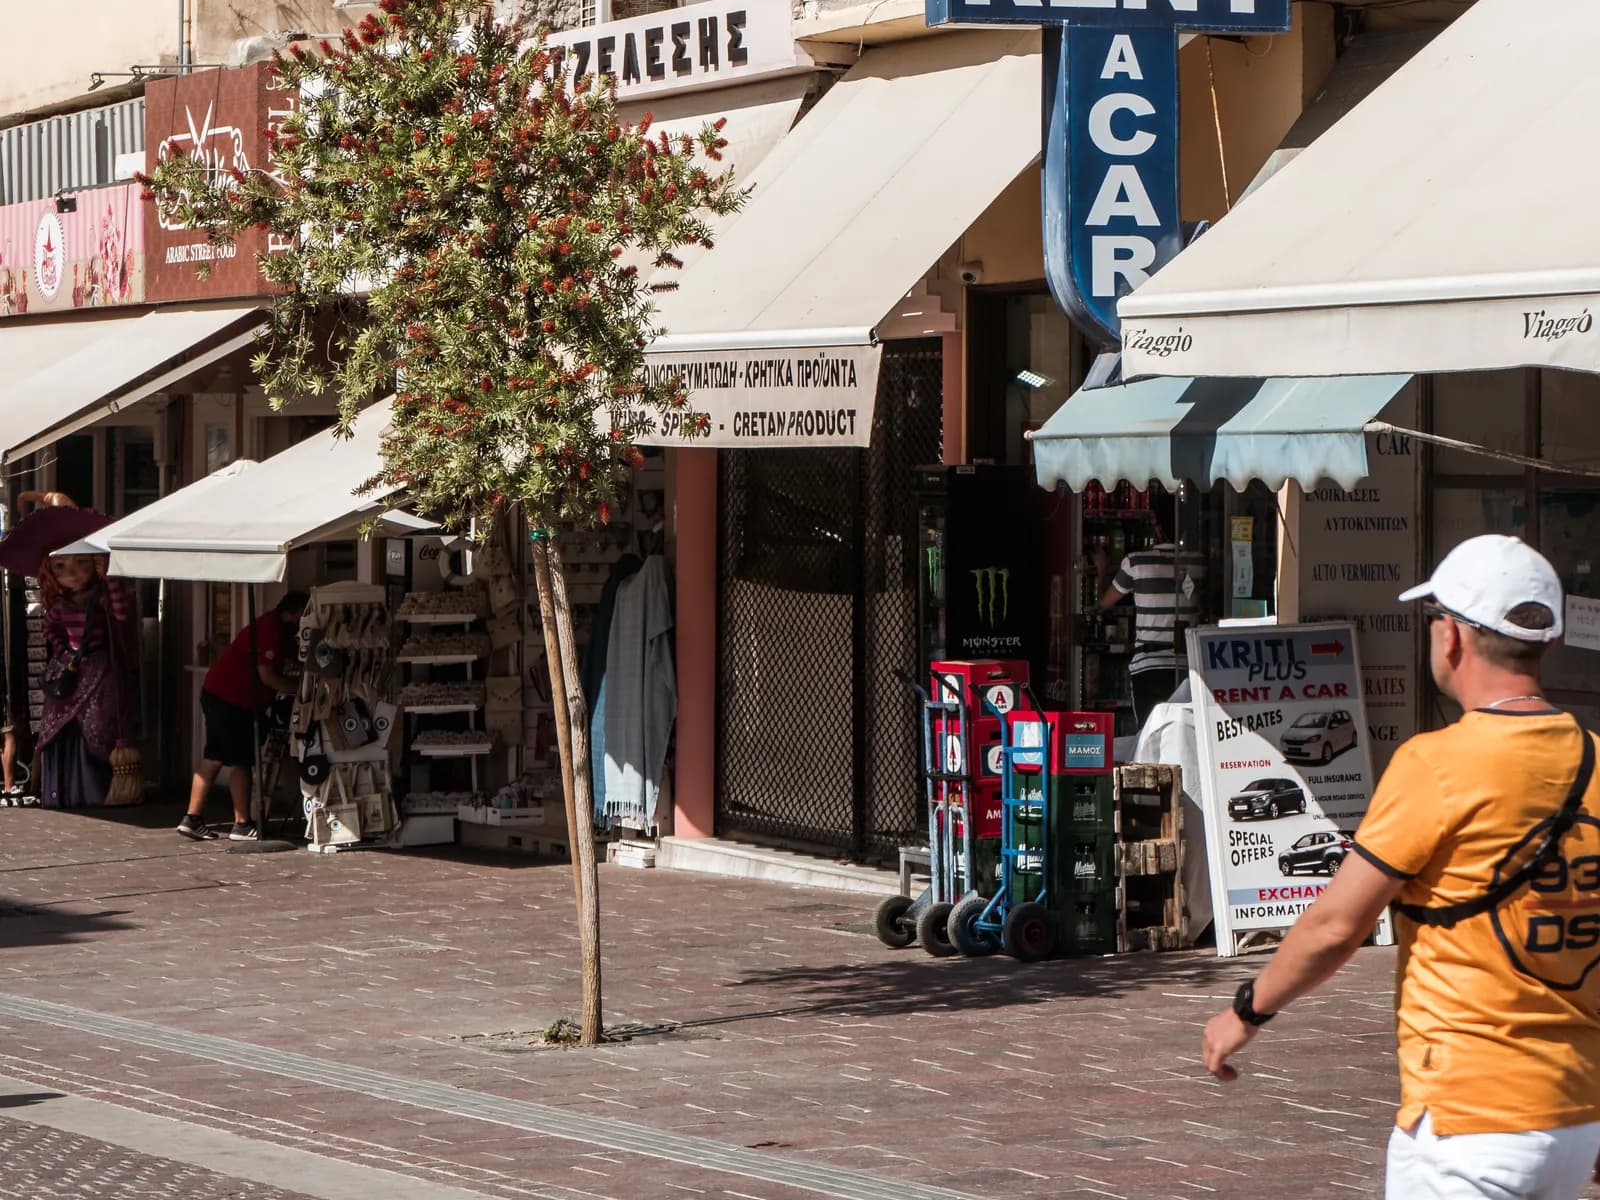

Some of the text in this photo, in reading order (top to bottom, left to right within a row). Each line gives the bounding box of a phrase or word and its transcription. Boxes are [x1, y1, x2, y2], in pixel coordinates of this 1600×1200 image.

[1100, 34, 1144, 80] A
[1085, 92, 1161, 297] CAR
[165, 246, 190, 264] ARABIC
[191, 243, 214, 261] STREET
[745, 359, 793, 388] ΚΡΗΤΙΚΑ
[797, 352, 857, 388] ΠΡΟΪΟΝΤΑ
[734, 411, 784, 437] CRETAN
[787, 409, 857, 436] PRODUCT
[1376, 433, 1411, 456] CAR
[1312, 563, 1400, 582] AUTO VERMIETUNG
[1369, 614, 1409, 633] VOITURE
[962, 635, 1022, 648] MONSTER
[1208, 638, 1296, 670] KRITI
[1248, 660, 1307, 682] PLUS
[1213, 682, 1349, 704] RENT A CAR
[1365, 677, 1405, 696] RATES
[1216, 709, 1283, 742] BEST RATES
[1069, 746, 1101, 755] ΜΑΜΟΣ
[1220, 759, 1272, 769] RESERVATION
[1308, 773, 1362, 784] FULL INSURANCE
[1229, 829, 1273, 848] SPECIAL
[1231, 846, 1274, 867] OFFERS
[1258, 886, 1328, 901] EXCHAN
[1235, 903, 1312, 919] INFORMATI
